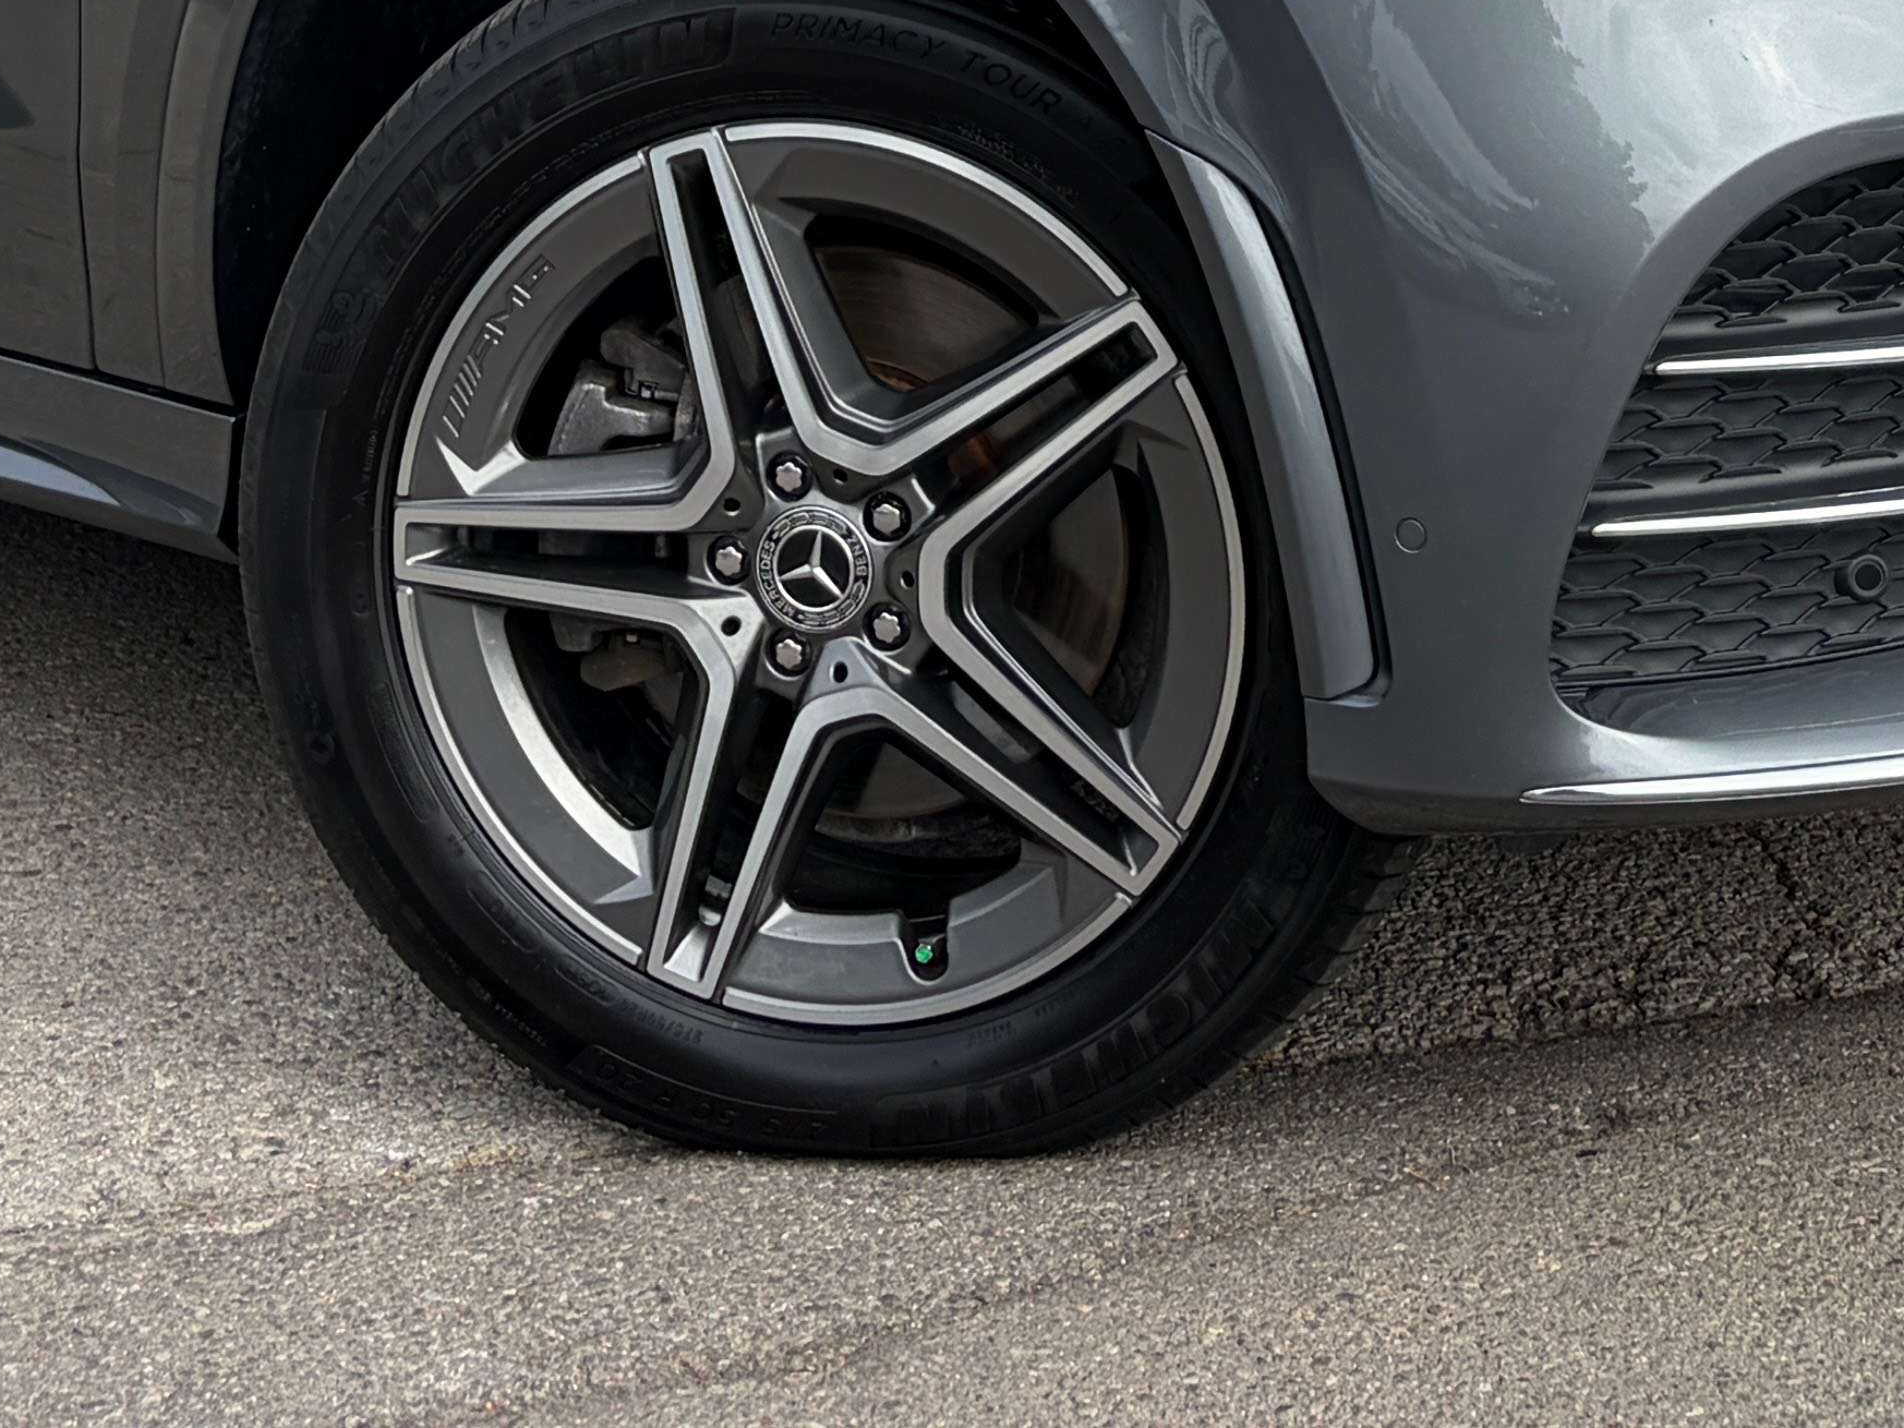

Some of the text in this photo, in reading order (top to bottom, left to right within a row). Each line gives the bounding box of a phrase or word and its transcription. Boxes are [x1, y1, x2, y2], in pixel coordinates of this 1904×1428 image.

[769, 10, 1063, 117] PRIMACY TOUR
[759, 540, 797, 618] MERCEDES
